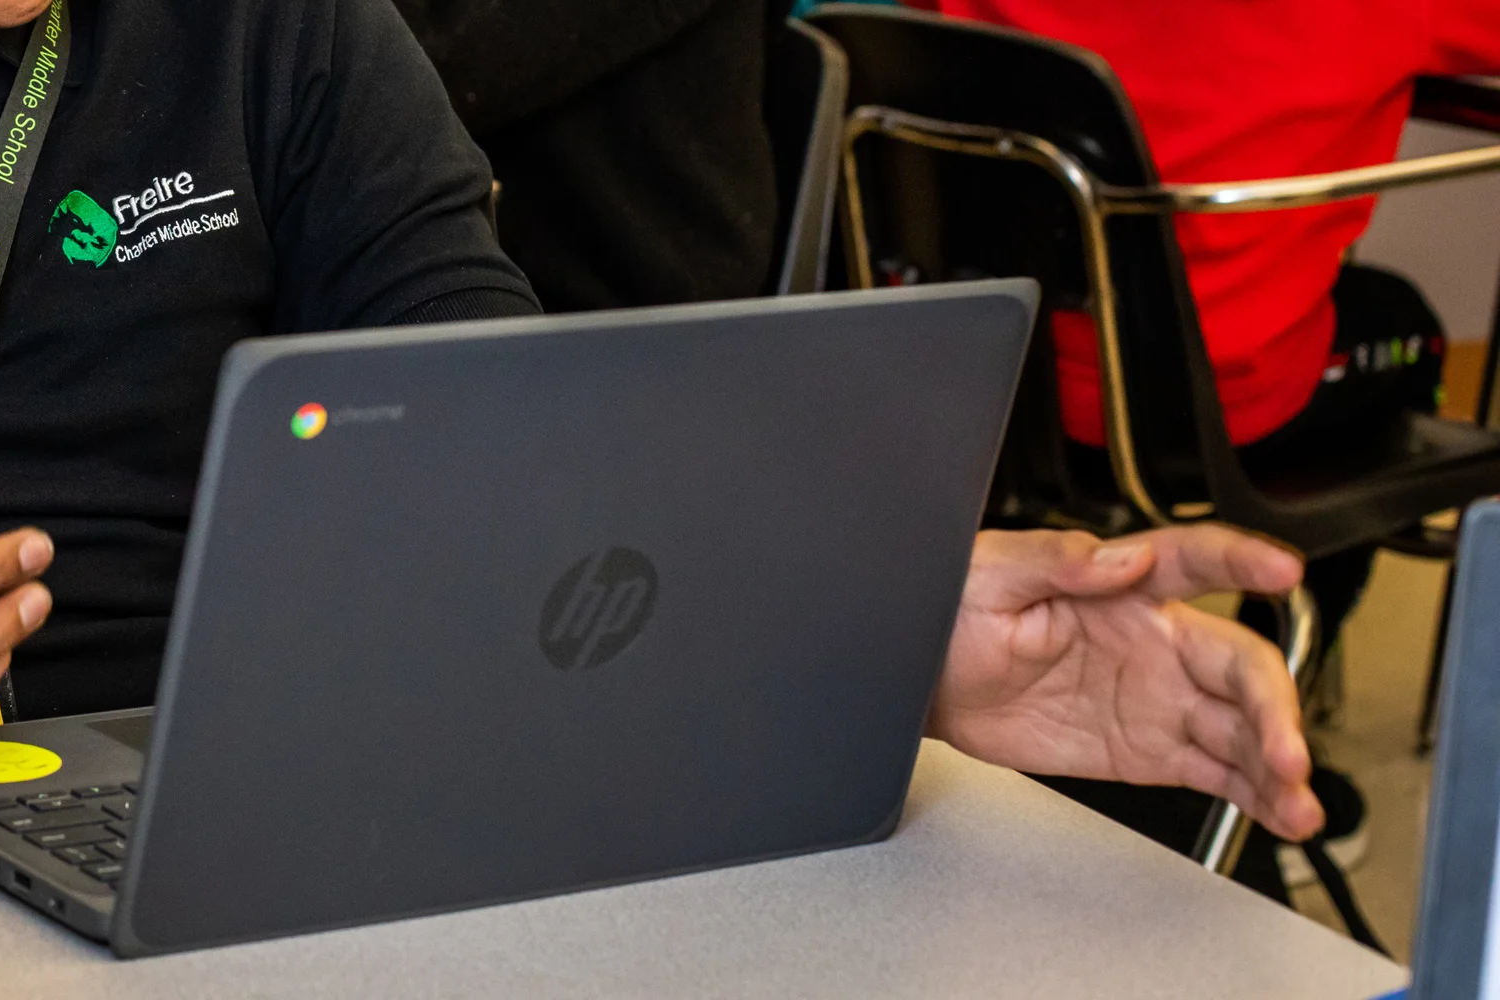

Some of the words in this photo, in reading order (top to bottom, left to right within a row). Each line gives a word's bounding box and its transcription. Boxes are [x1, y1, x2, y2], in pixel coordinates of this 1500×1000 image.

[22, 45, 58, 109] Middle
[112, 171, 195, 225] Freire
[115, 230, 159, 263] Charter
[156, 218, 201, 243] Middle
[200, 207, 239, 232] School
